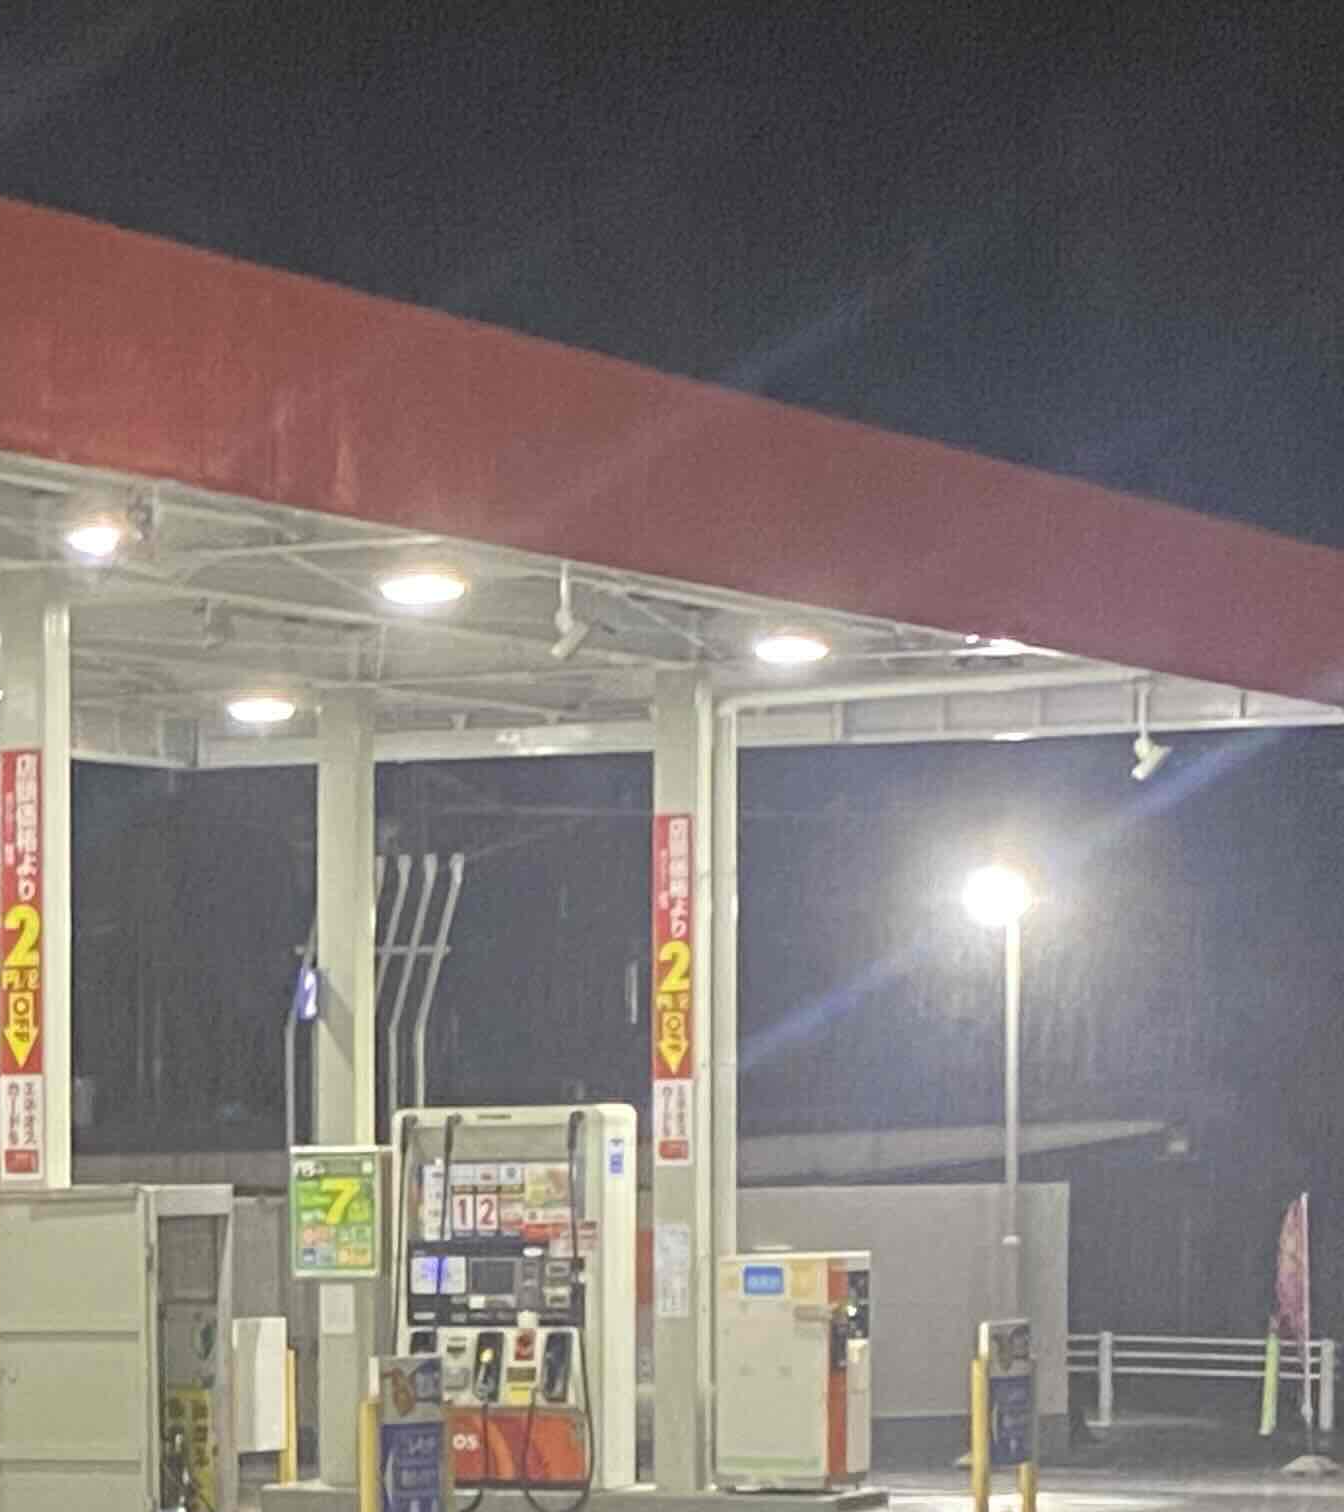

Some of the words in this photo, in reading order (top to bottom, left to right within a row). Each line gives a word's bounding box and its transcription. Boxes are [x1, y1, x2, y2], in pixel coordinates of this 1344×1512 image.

[2, 904, 41, 966] 2
[658, 940, 691, 990] 2
[13, 997, 31, 1044] OFF
[321, 1179, 358, 1226] 7
